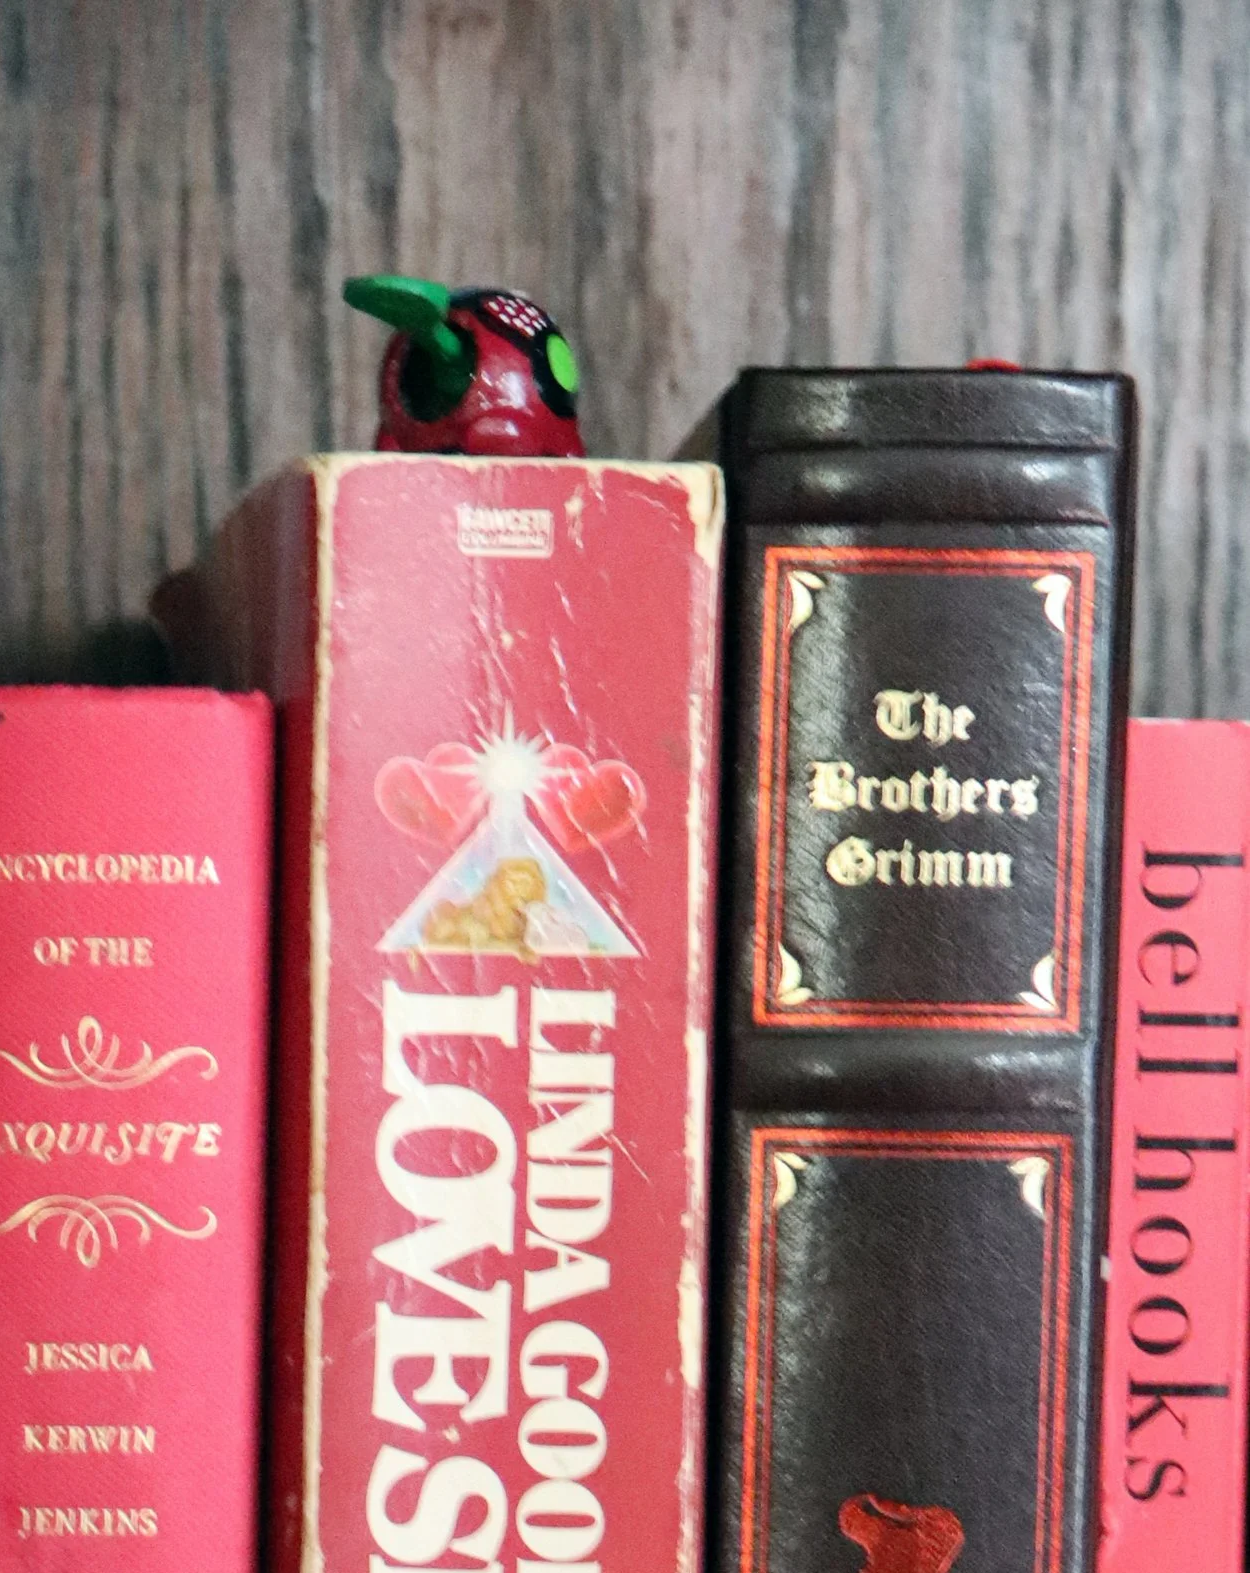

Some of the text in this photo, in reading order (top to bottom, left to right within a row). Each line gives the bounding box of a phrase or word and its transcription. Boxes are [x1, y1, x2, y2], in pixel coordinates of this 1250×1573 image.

[875, 690, 975, 745] The
[806, 764, 1040, 823] Brothers
[825, 836, 1012, 888] Grimm
[33, 937, 153, 966] OF THE
[523, 985, 617, 1313] LINDA
[1124, 842, 1244, 1503] bell hooks
[371, 978, 518, 1433] LOVE
[25, 1343, 154, 1373] JESSICA
[24, 1426, 156, 1453] KERWIN
[20, 1508, 158, 1537] JENKINS
